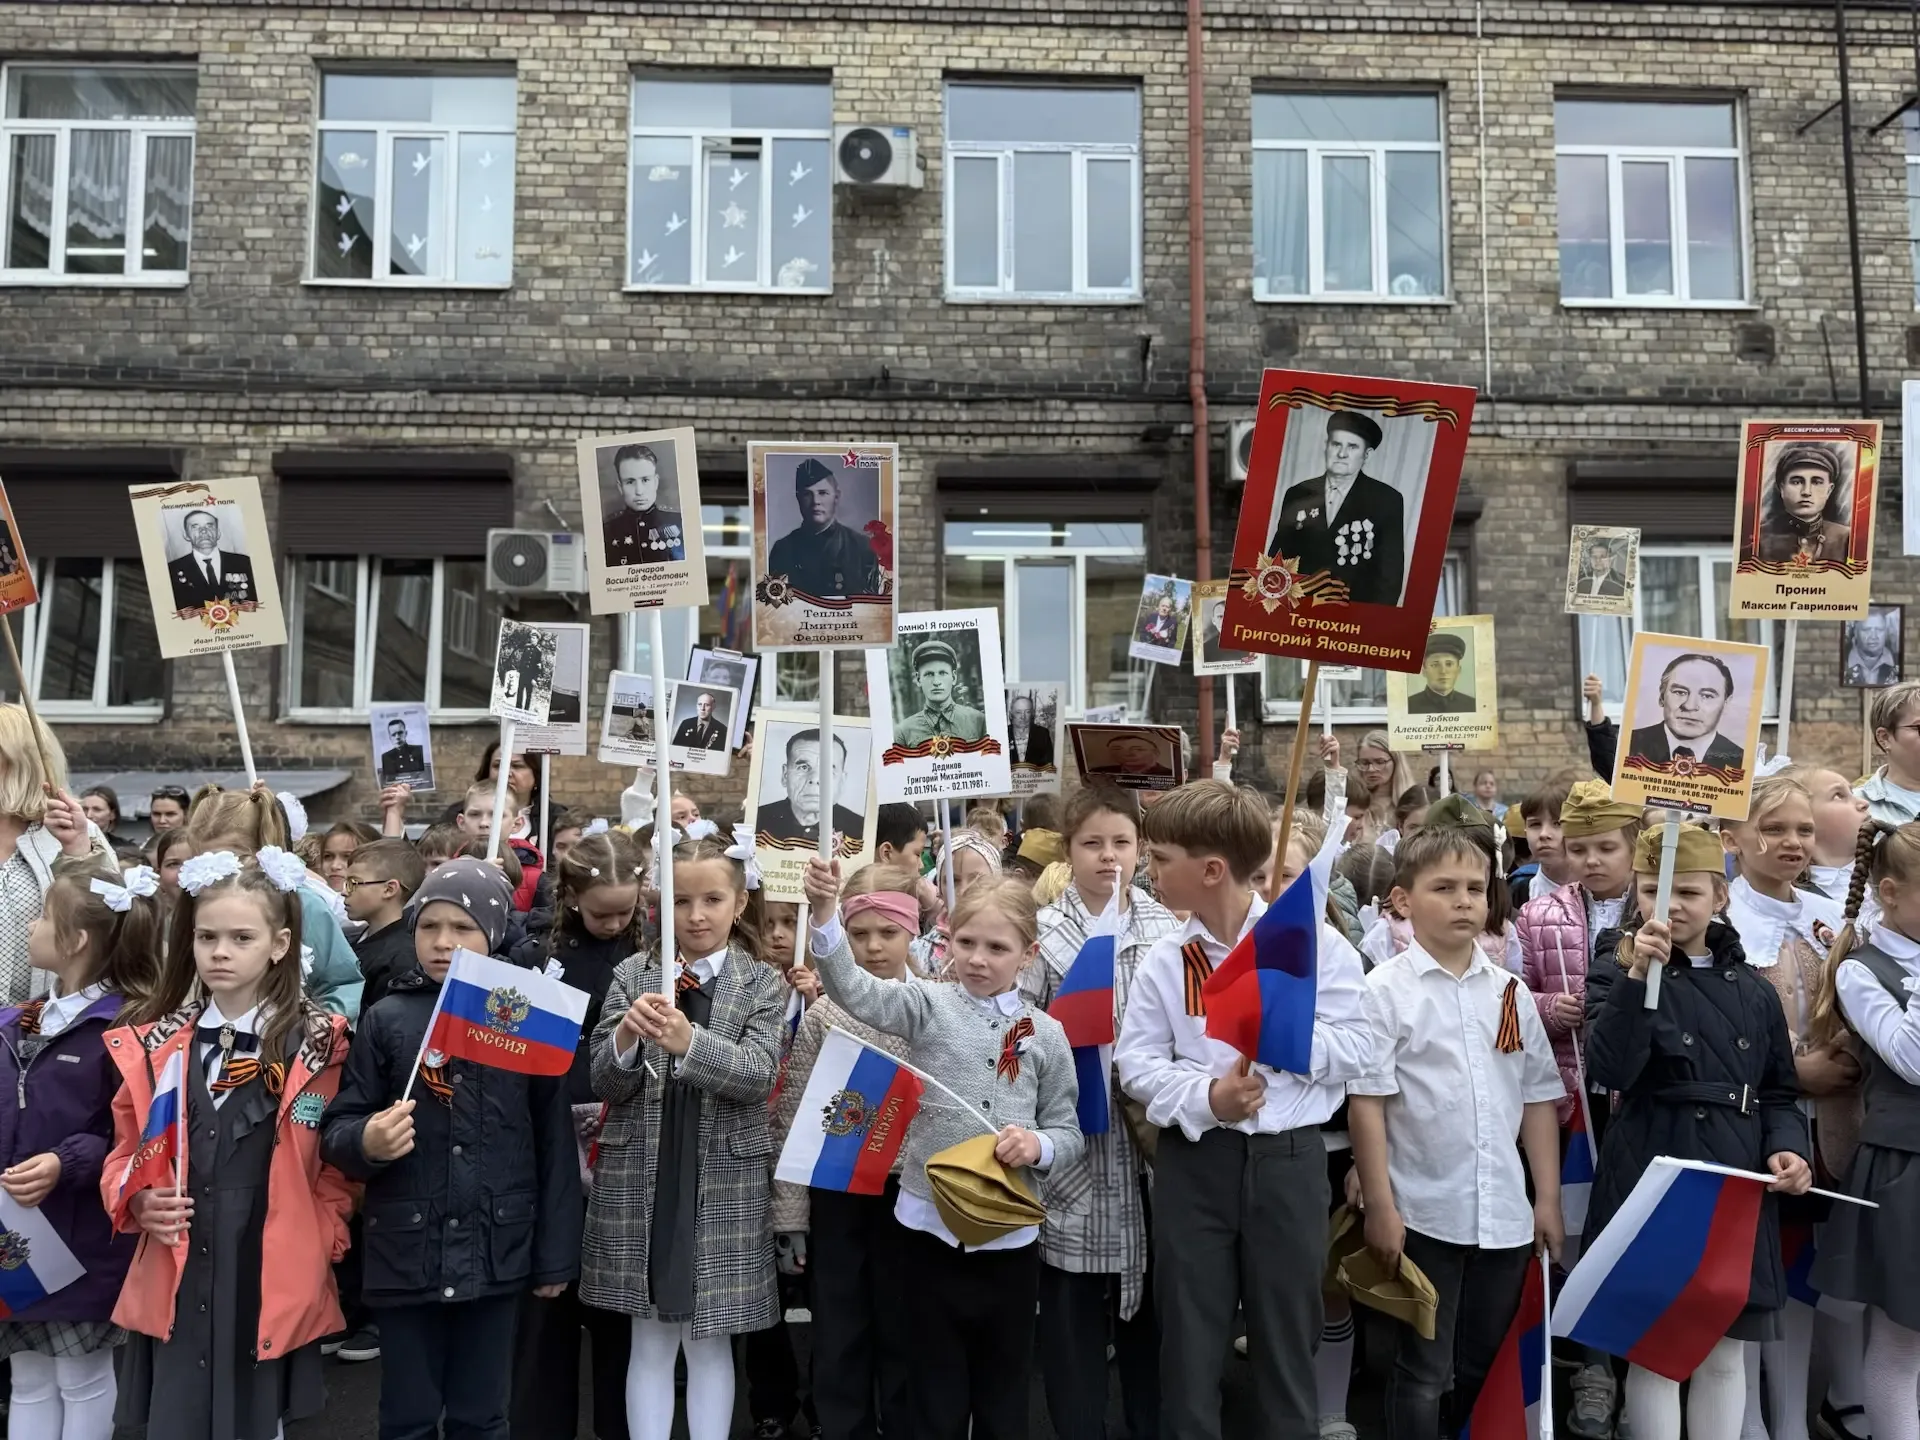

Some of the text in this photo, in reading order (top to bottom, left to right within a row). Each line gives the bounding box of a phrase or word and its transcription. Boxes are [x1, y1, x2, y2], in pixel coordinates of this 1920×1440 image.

[628, 565, 665, 575] Гончаров
[605, 572, 689, 585] Василий Федотович
[629, 589, 667, 598] полковник
[1775, 584, 1827, 597] Пронин
[1741, 600, 1858, 613] Максим Гаврилович
[803, 609, 853, 618] Теплых
[798, 620, 858, 631] Дмитрий
[898, 618, 978, 632] омню! Я горжусь!
[1288, 612, 1361, 635] Тетюхин
[214, 627, 231, 635] ЛЯХ
[214, 633, 254, 643] Петрович
[793, 633, 864, 643] Федорович
[1233, 623, 1412, 661] Григорий Яковлевич
[189, 640, 262, 654] старший сержант
[1425, 714, 1460, 723] Зобков
[1393, 724, 1493, 733] Алексей Алексеевич
[907, 770, 983, 785] Григорий Михайлович
[903, 784, 938, 796] 20.01.1914
[951, 780, 984, 791] 02.11.1981
[1643, 784, 1677, 795] 01.01.1926
[1681, 789, 1719, 801] 04.06.2002
[1663, 779, 1699, 790] ВЛАДИМИР
[1700, 784, 1745, 796] ТИМОФЕЕВИЧ
[780, 860, 807, 870] ЕВСТ
[466, 1026, 528, 1056] РОССИЯ
